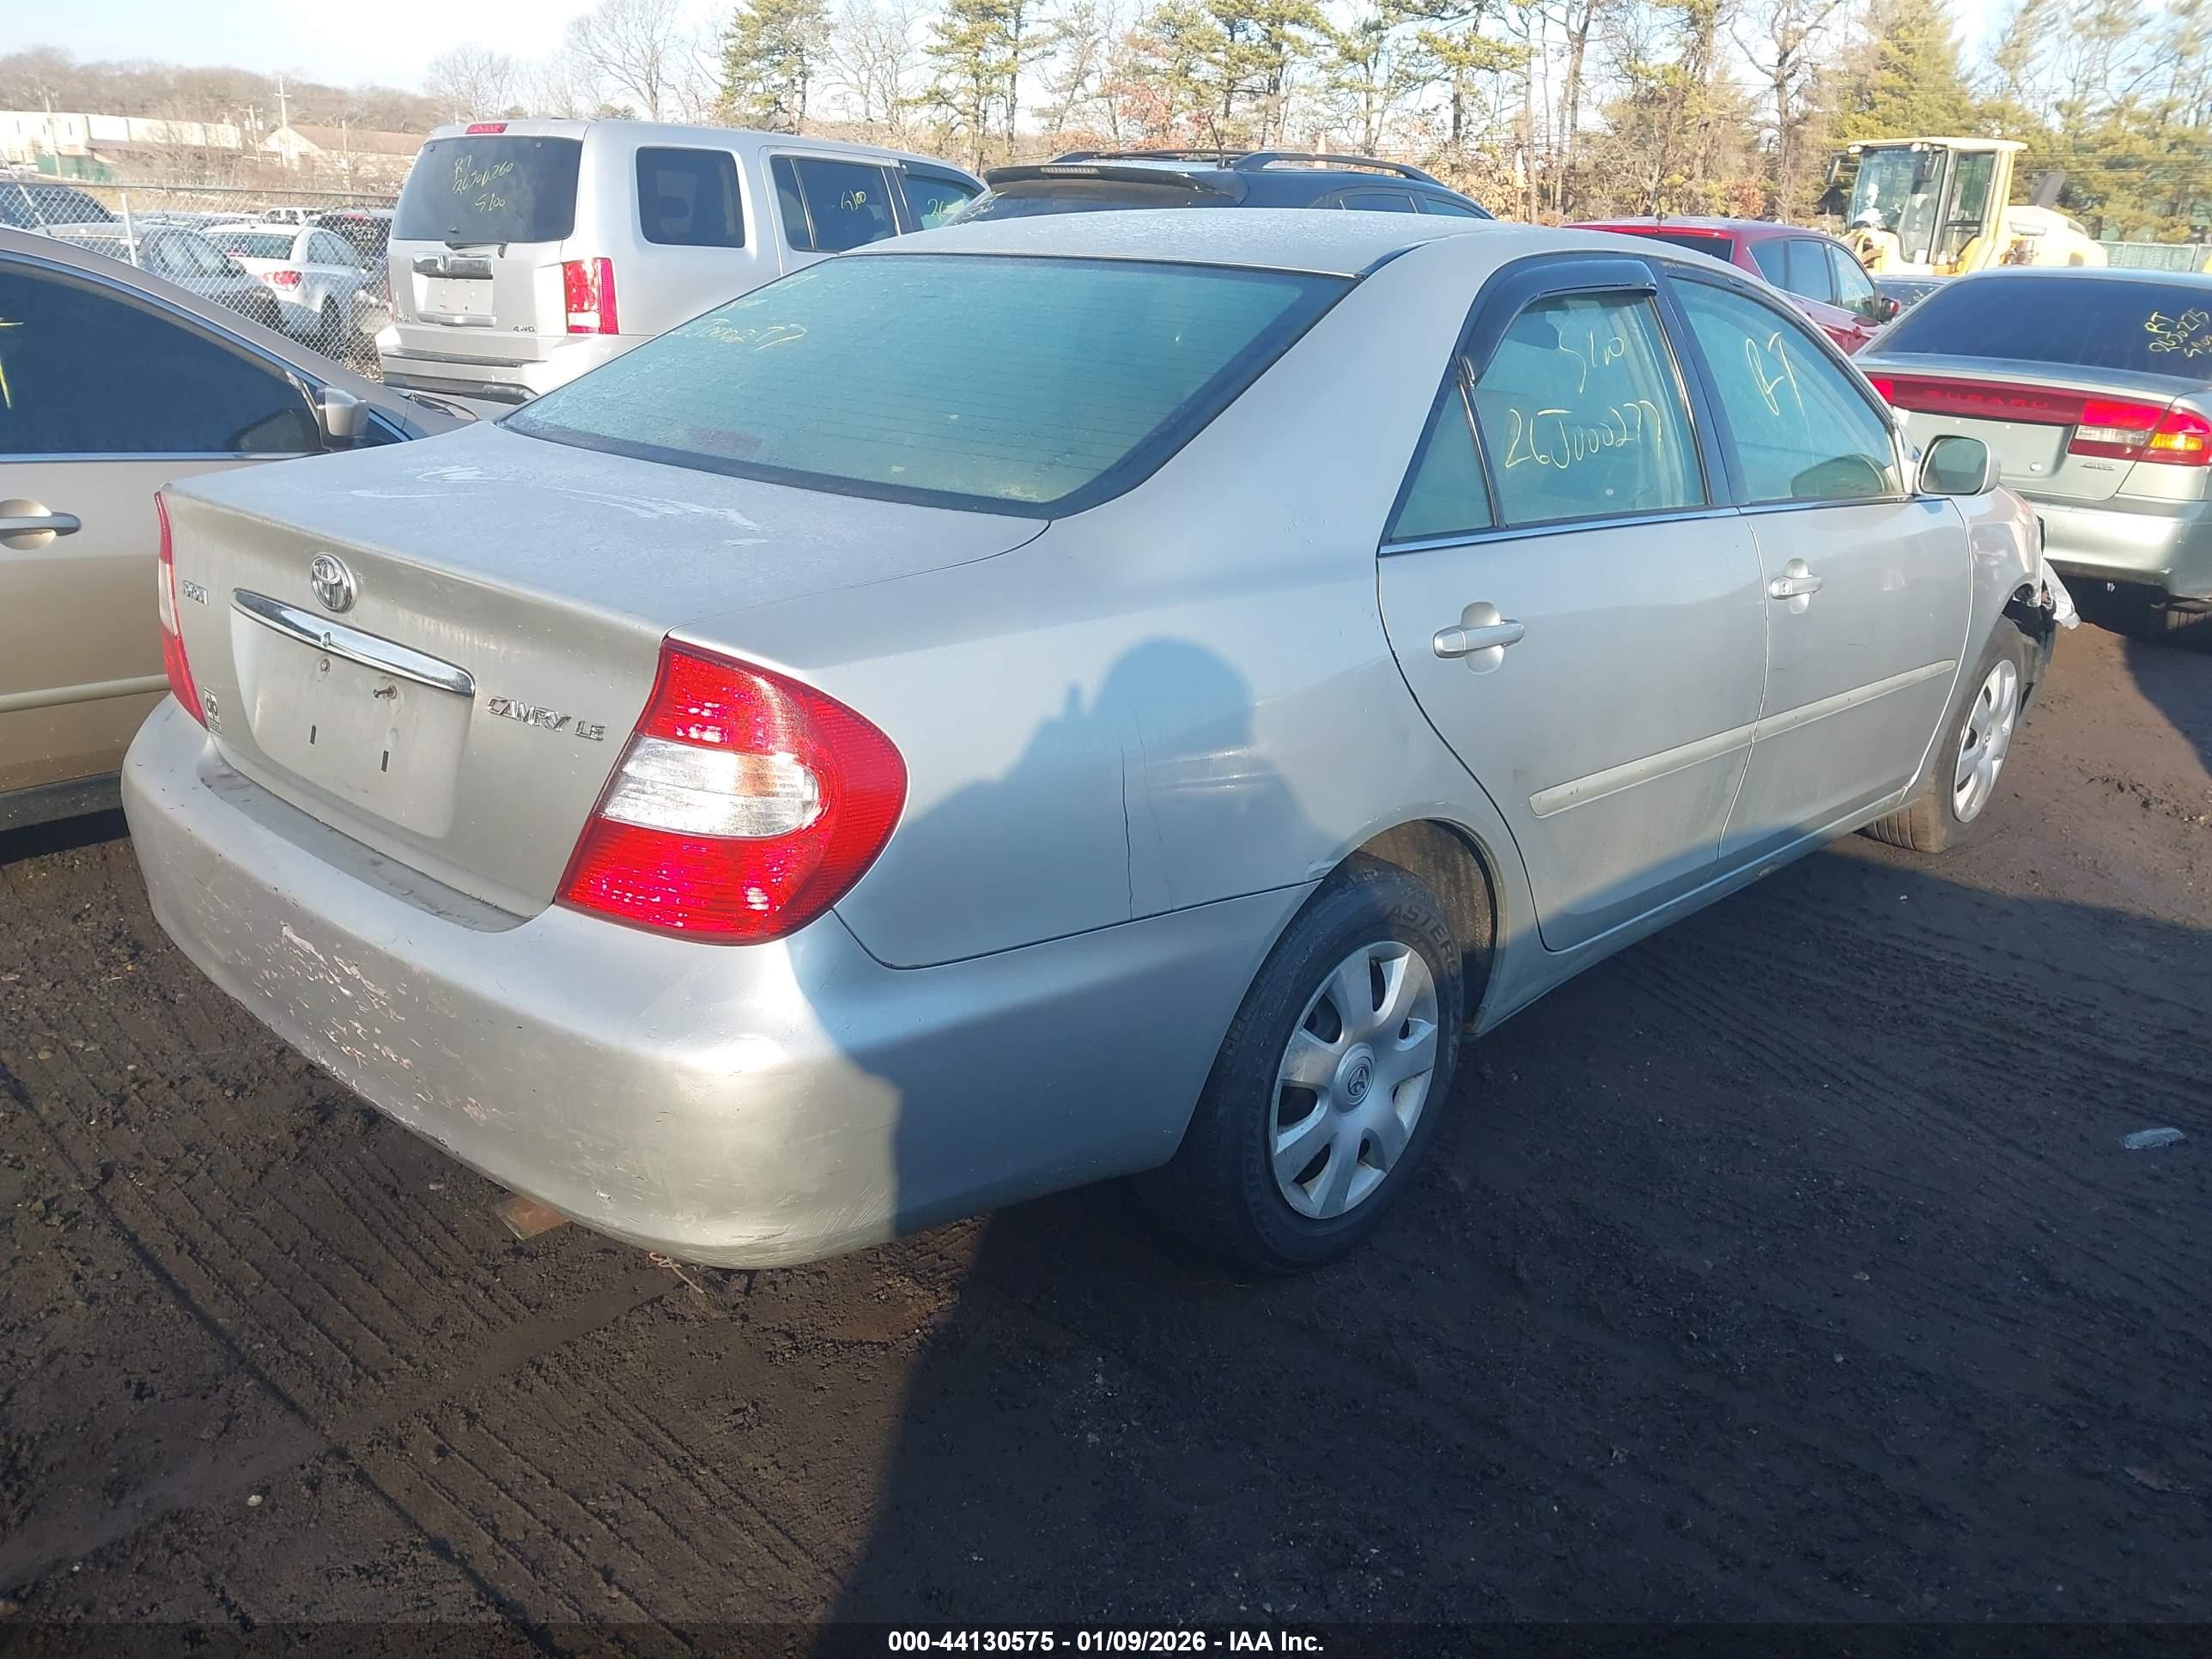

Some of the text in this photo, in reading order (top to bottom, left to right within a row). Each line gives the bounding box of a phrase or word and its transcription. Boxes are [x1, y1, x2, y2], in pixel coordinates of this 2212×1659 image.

[1923, 389, 2049, 409] SUBARU
[487, 696, 607, 742] CAMRY LE
